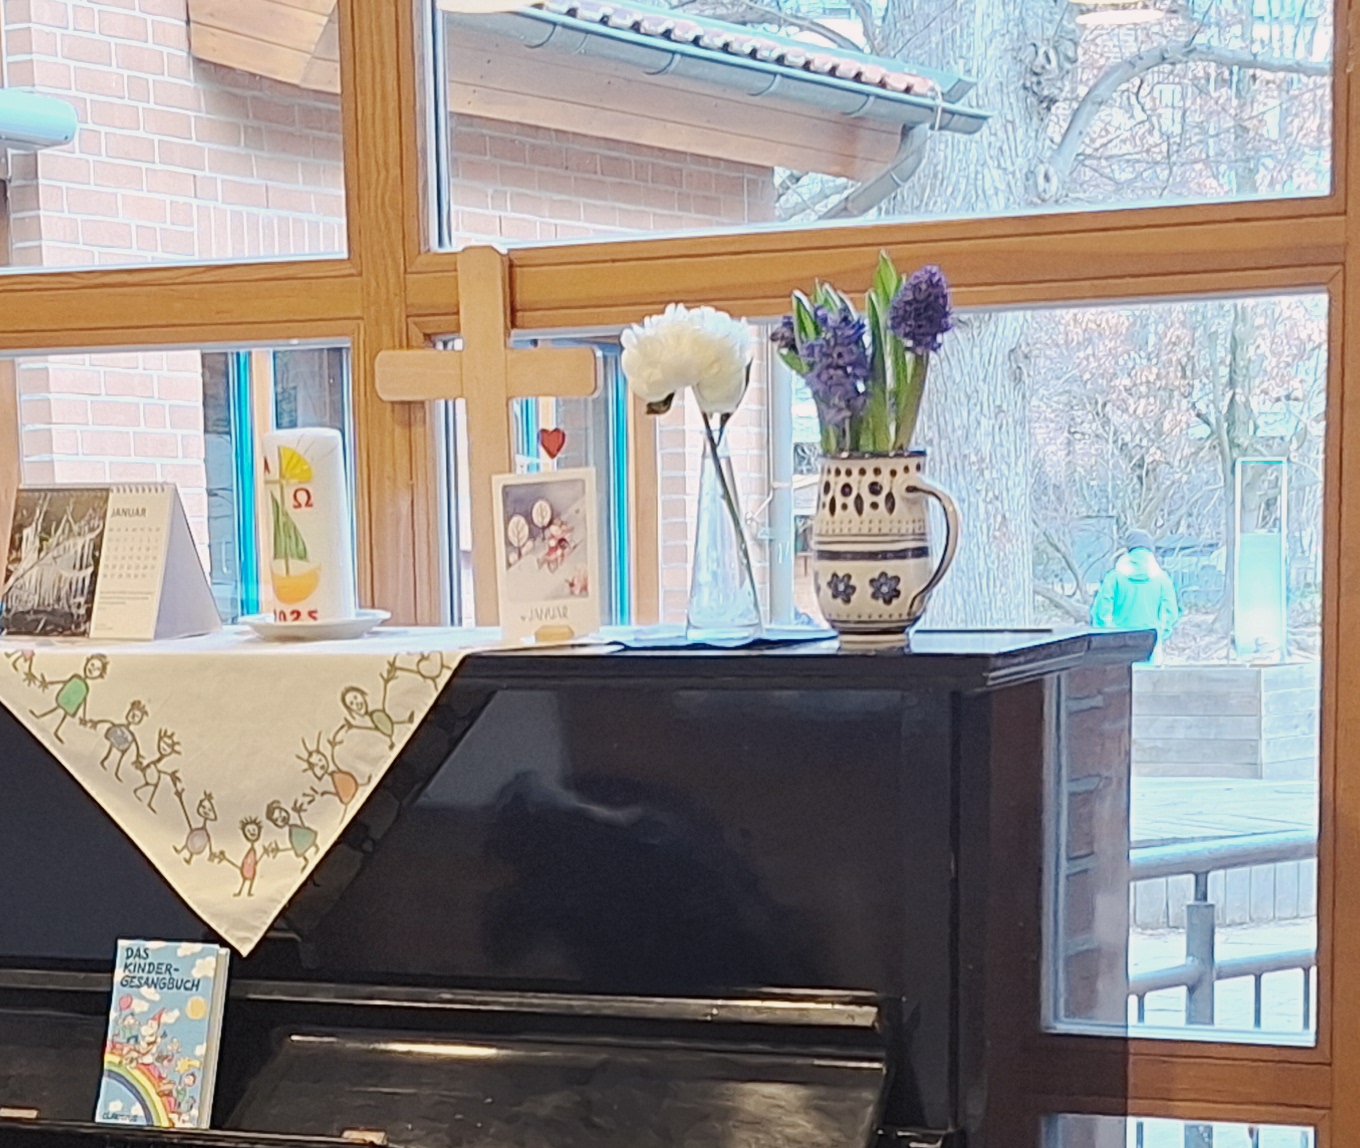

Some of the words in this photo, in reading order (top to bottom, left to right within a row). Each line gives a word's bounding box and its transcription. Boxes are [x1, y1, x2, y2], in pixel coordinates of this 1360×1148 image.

[110, 507, 147, 518] JANUAR
[273, 609, 319, 622] 025
[125, 947, 150, 960] DAS
[123, 962, 180, 976] KINDER-
[120, 976, 200, 992] GESANGBUCH
